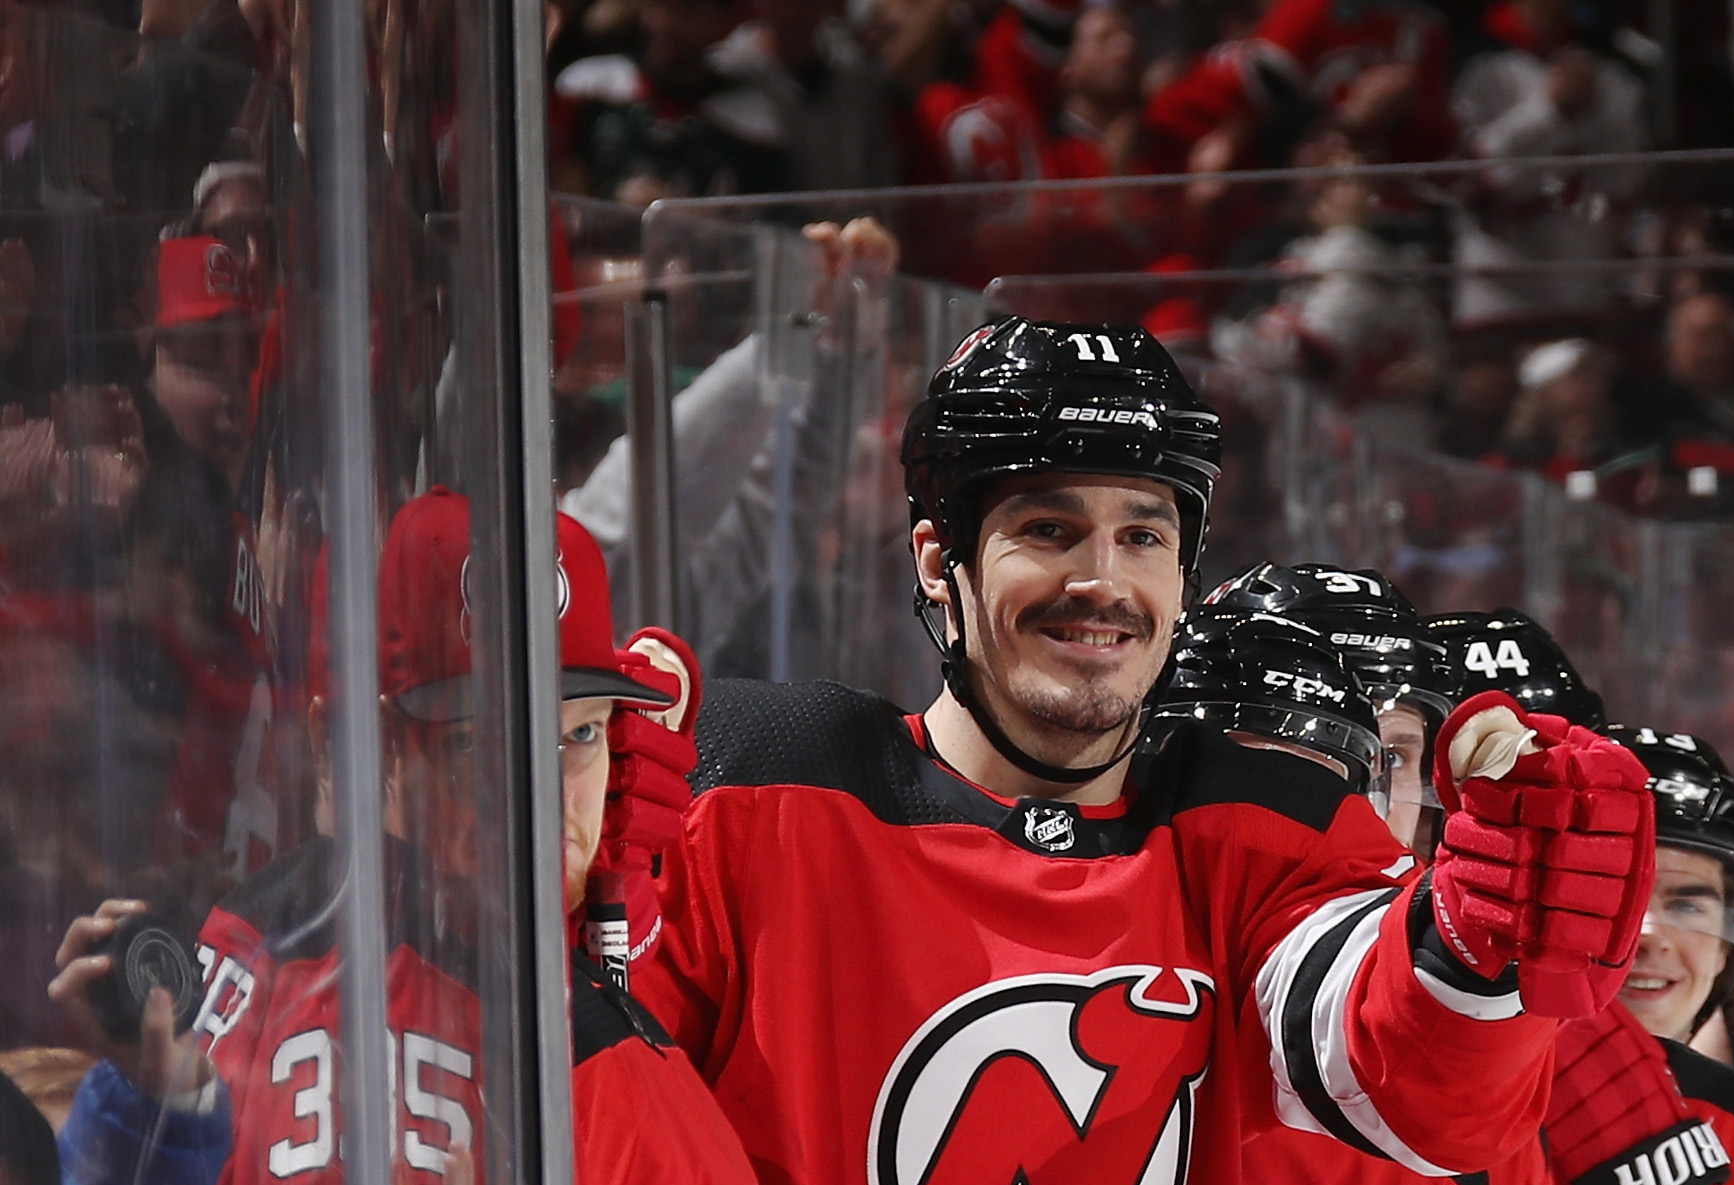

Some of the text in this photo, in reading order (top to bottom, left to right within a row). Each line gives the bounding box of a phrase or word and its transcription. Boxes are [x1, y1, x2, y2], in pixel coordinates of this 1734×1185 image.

[1067, 333, 1119, 363] 11
[1058, 407, 1158, 429] BAUER
[1330, 633, 1411, 651] BAUER
[1464, 640, 1530, 679] 44
[1262, 670, 1346, 704] CCM
